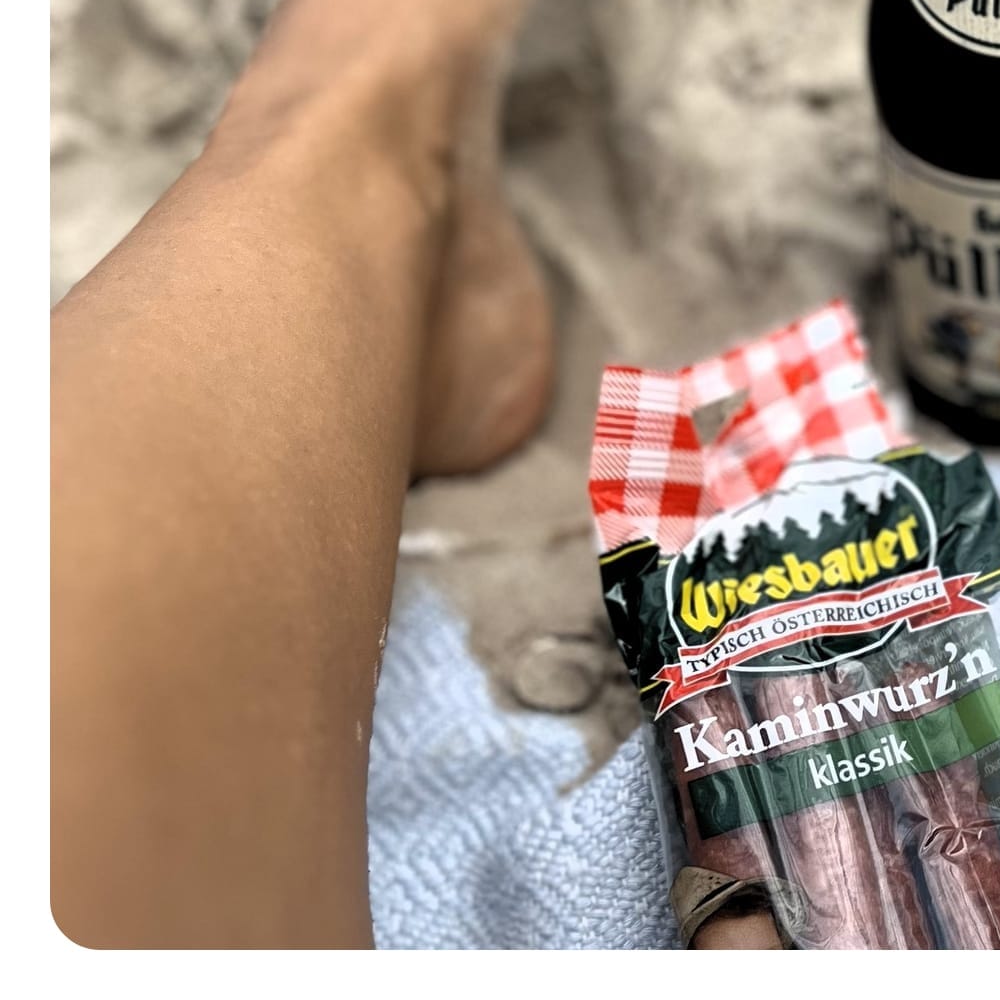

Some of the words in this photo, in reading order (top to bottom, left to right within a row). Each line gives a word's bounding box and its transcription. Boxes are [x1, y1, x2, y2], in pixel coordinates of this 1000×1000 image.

[680, 514, 919, 633] Wiesbauer
[687, 625, 766, 674] TYPISCH
[772, 582, 939, 635] ÖSTERREICHISCH
[807, 734, 914, 790] klassik
